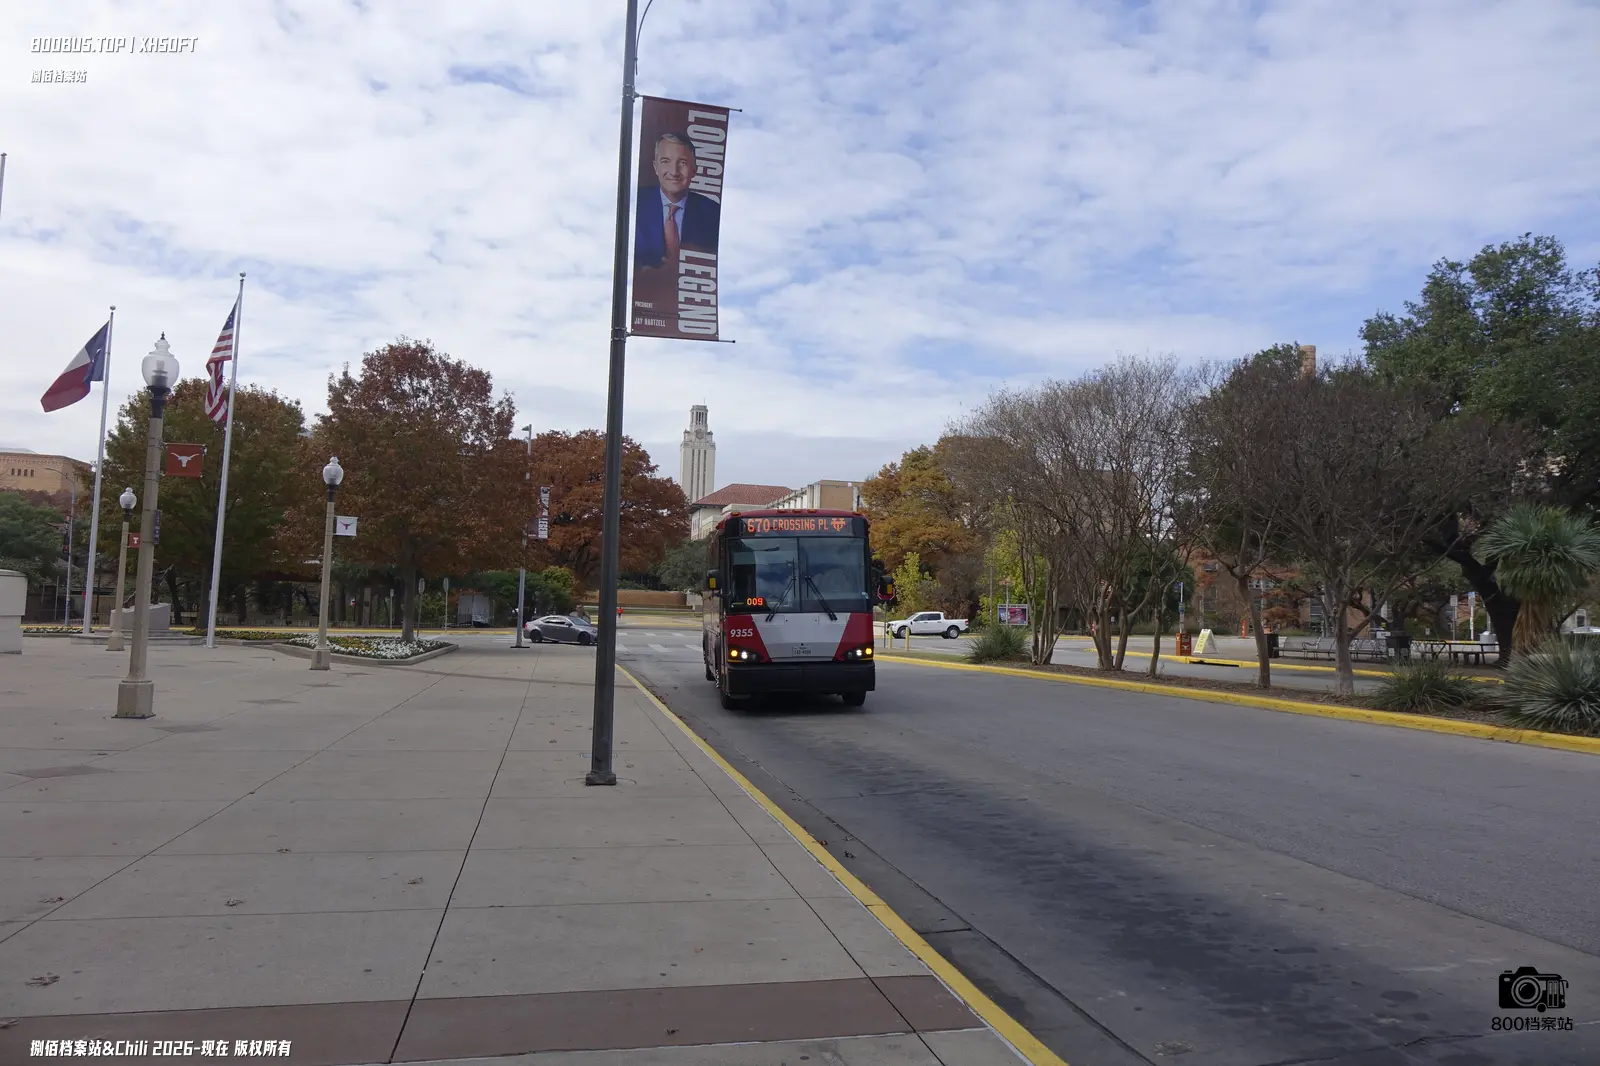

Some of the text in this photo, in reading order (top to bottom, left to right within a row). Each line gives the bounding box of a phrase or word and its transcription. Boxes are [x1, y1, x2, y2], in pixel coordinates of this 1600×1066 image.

[678, 249, 717, 335] LEGEND
[634, 317, 643, 325] JAY
[747, 518, 771, 533] 670
[772, 518, 816, 531] CROSSING
[818, 518, 829, 531] PL
[746, 597, 764, 606] 009
[730, 629, 754, 638] 9355
